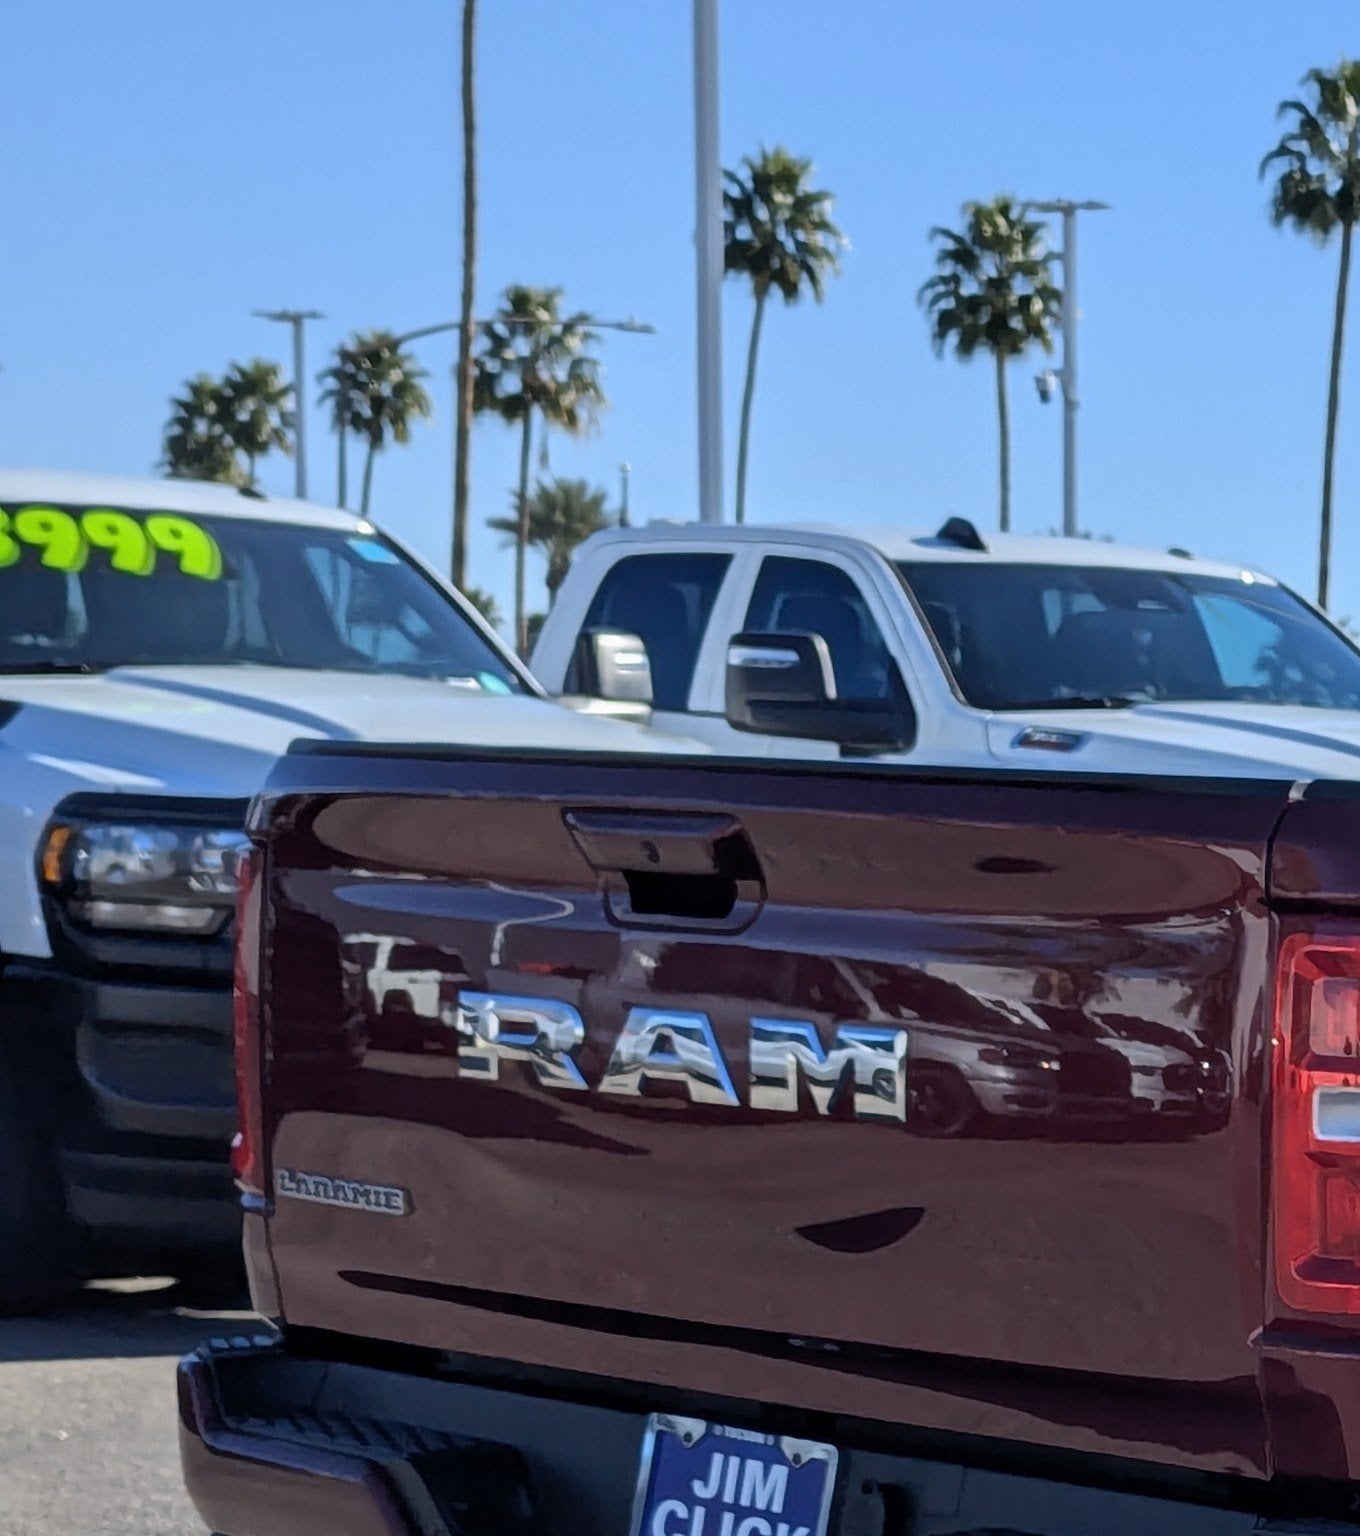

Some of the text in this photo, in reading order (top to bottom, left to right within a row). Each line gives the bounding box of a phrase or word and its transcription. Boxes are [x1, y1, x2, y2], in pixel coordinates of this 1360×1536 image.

[457, 990, 908, 1123] RAM
[279, 1171, 402, 1211] LARAMIE
[690, 1451, 789, 1514] JIM
